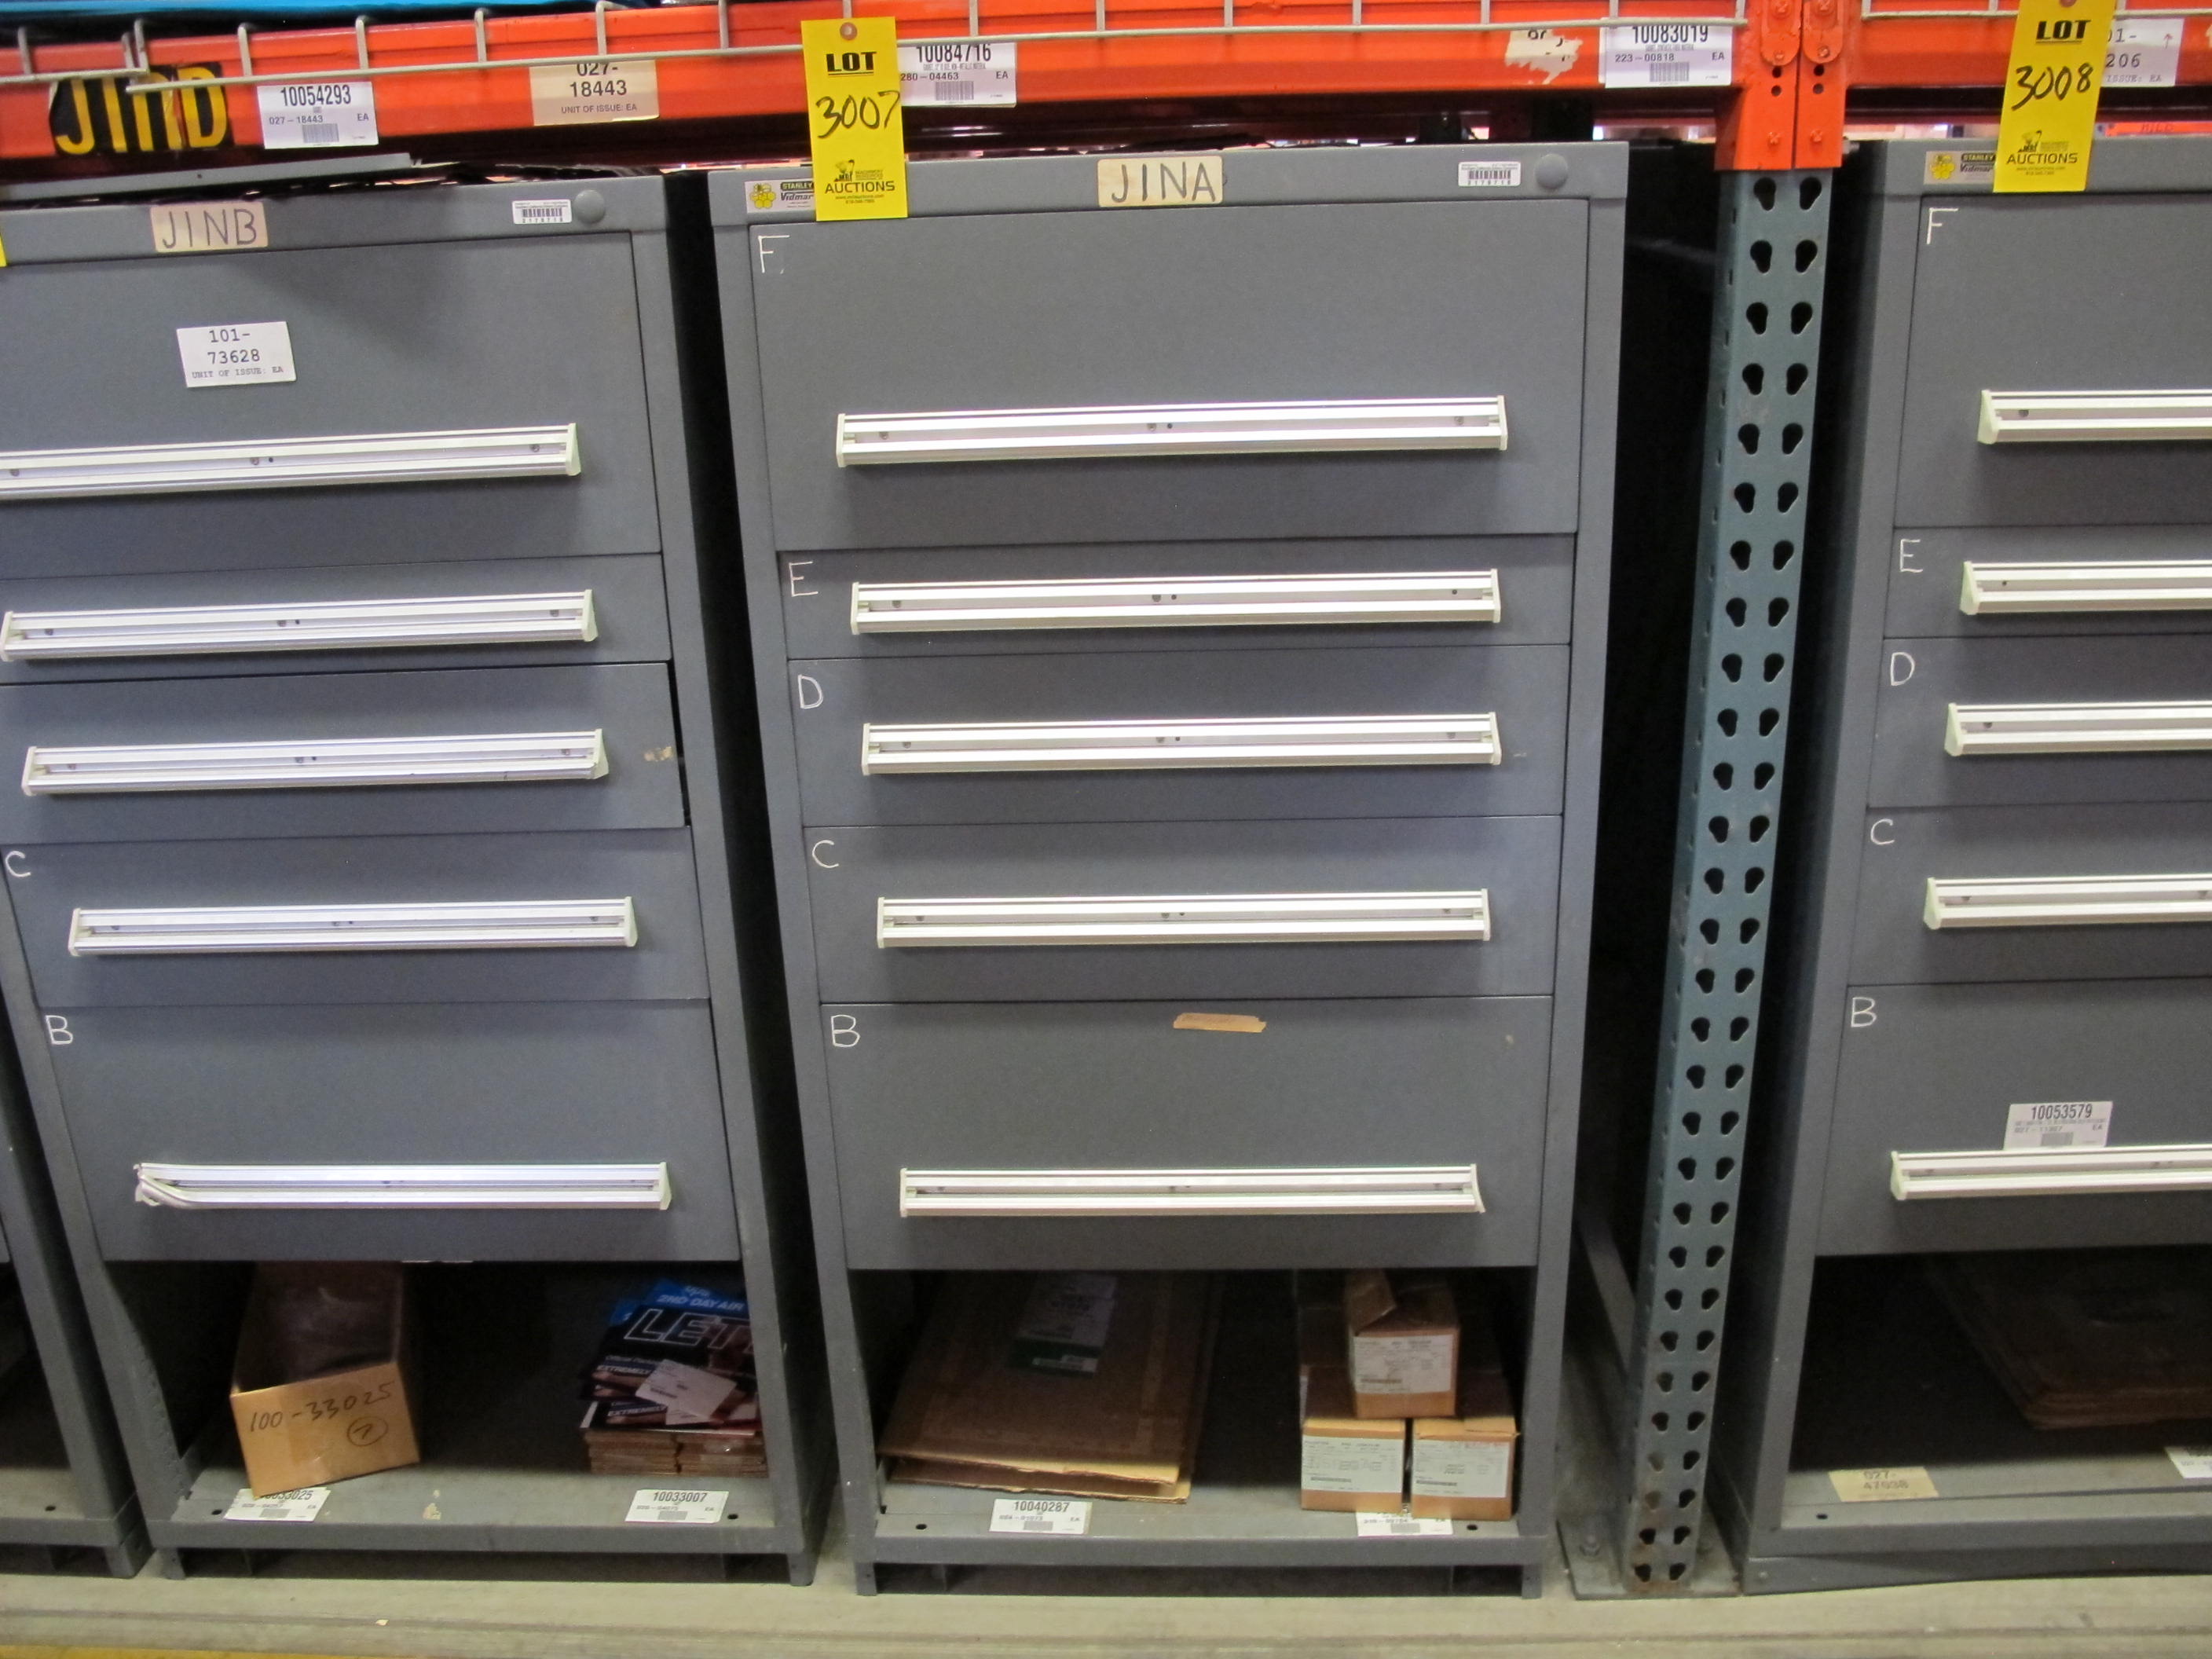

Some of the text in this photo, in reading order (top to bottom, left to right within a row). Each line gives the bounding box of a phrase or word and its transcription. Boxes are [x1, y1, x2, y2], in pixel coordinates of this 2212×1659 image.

[1632, 25, 1708, 43] 10083019
[2036, 20, 2091, 39] LOT
[2108, 28, 2137, 42] 1-
[826, 51, 877, 72] LOT
[916, 44, 991, 62] 10084716
[1712, 52, 1725, 60] EA
[577, 63, 618, 76] 027-
[280, 85, 352, 106] 10054293
[570, 79, 627, 97] 18443
[2012, 62, 2093, 111] 3008
[357, 113, 369, 122] EA
[815, 90, 900, 139] 3007
[2007, 152, 2078, 164] AUCTIONS
[782, 181, 813, 190] STANLEY
[825, 181, 895, 194] AUCTIONS
[1111, 162, 1216, 203] JINA
[163, 208, 257, 249] JINB
[1927, 207, 1958, 245] F
[758, 234, 789, 273] F
[209, 328, 251, 342] 101-
[207, 349, 260, 364] 73628
[236, 368, 266, 376] ISSUE:
[1900, 539, 1924, 573] E
[789, 561, 819, 597] E
[1890, 651, 1916, 687] D
[798, 674, 824, 710] D
[1870, 819, 1895, 846] C
[5, 850, 32, 878] C
[812, 839, 840, 869] C
[1851, 996, 1877, 1028] B
[46, 1014, 74, 1046] B
[830, 1014, 861, 1049] B
[2031, 1104, 2093, 1119] 10053579
[657, 1295, 745, 1311] 2ND DAY AIR
[250, 1381, 395, 1433] 100-33025
[654, 1492, 708, 1502] 10033007
[1013, 1500, 1070, 1512] 10040287
